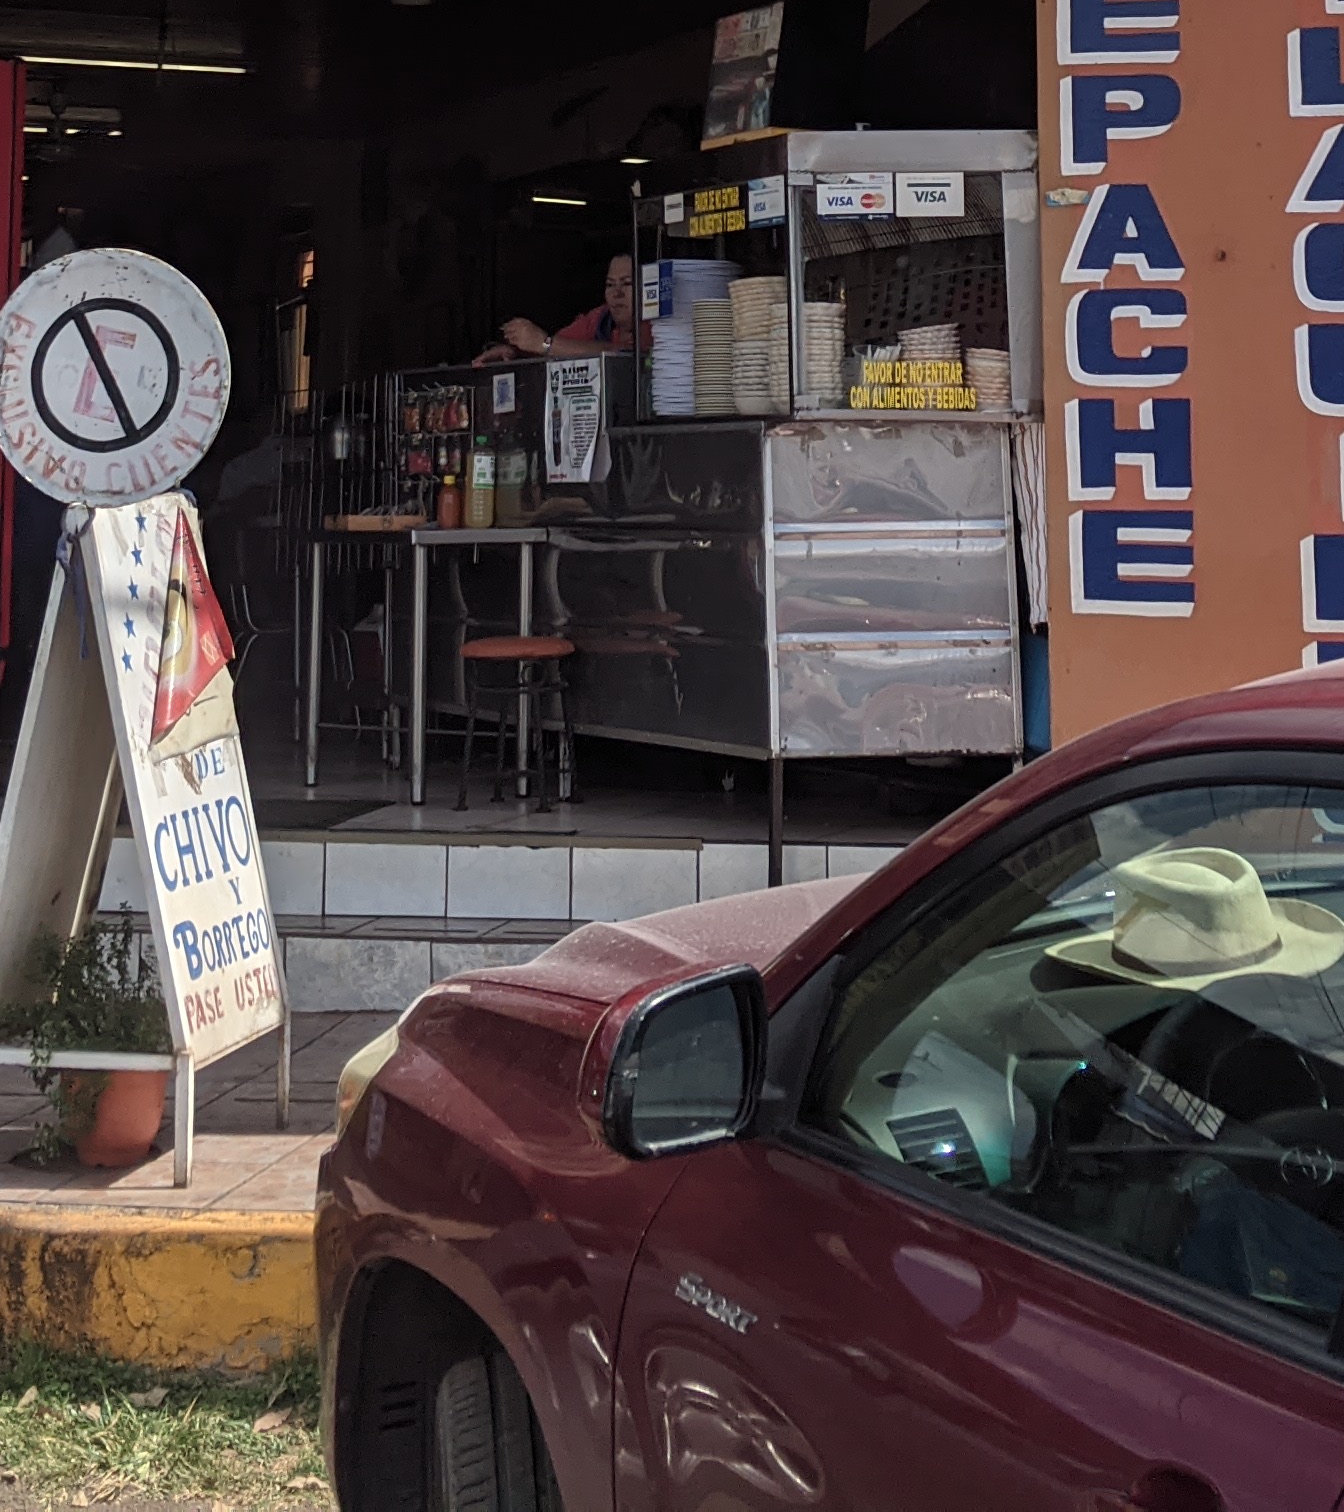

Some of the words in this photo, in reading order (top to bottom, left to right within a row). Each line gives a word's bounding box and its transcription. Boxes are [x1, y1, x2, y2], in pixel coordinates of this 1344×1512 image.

[826, 196, 853, 207] VISA
[913, 191, 947, 203] VISA
[195, 746, 225, 780] DE
[155, 796, 250, 892] CHIVO
[229, 876, 242, 905] Y
[173, 908, 270, 981] BORREGO
[184, 986, 224, 1034] PASE
